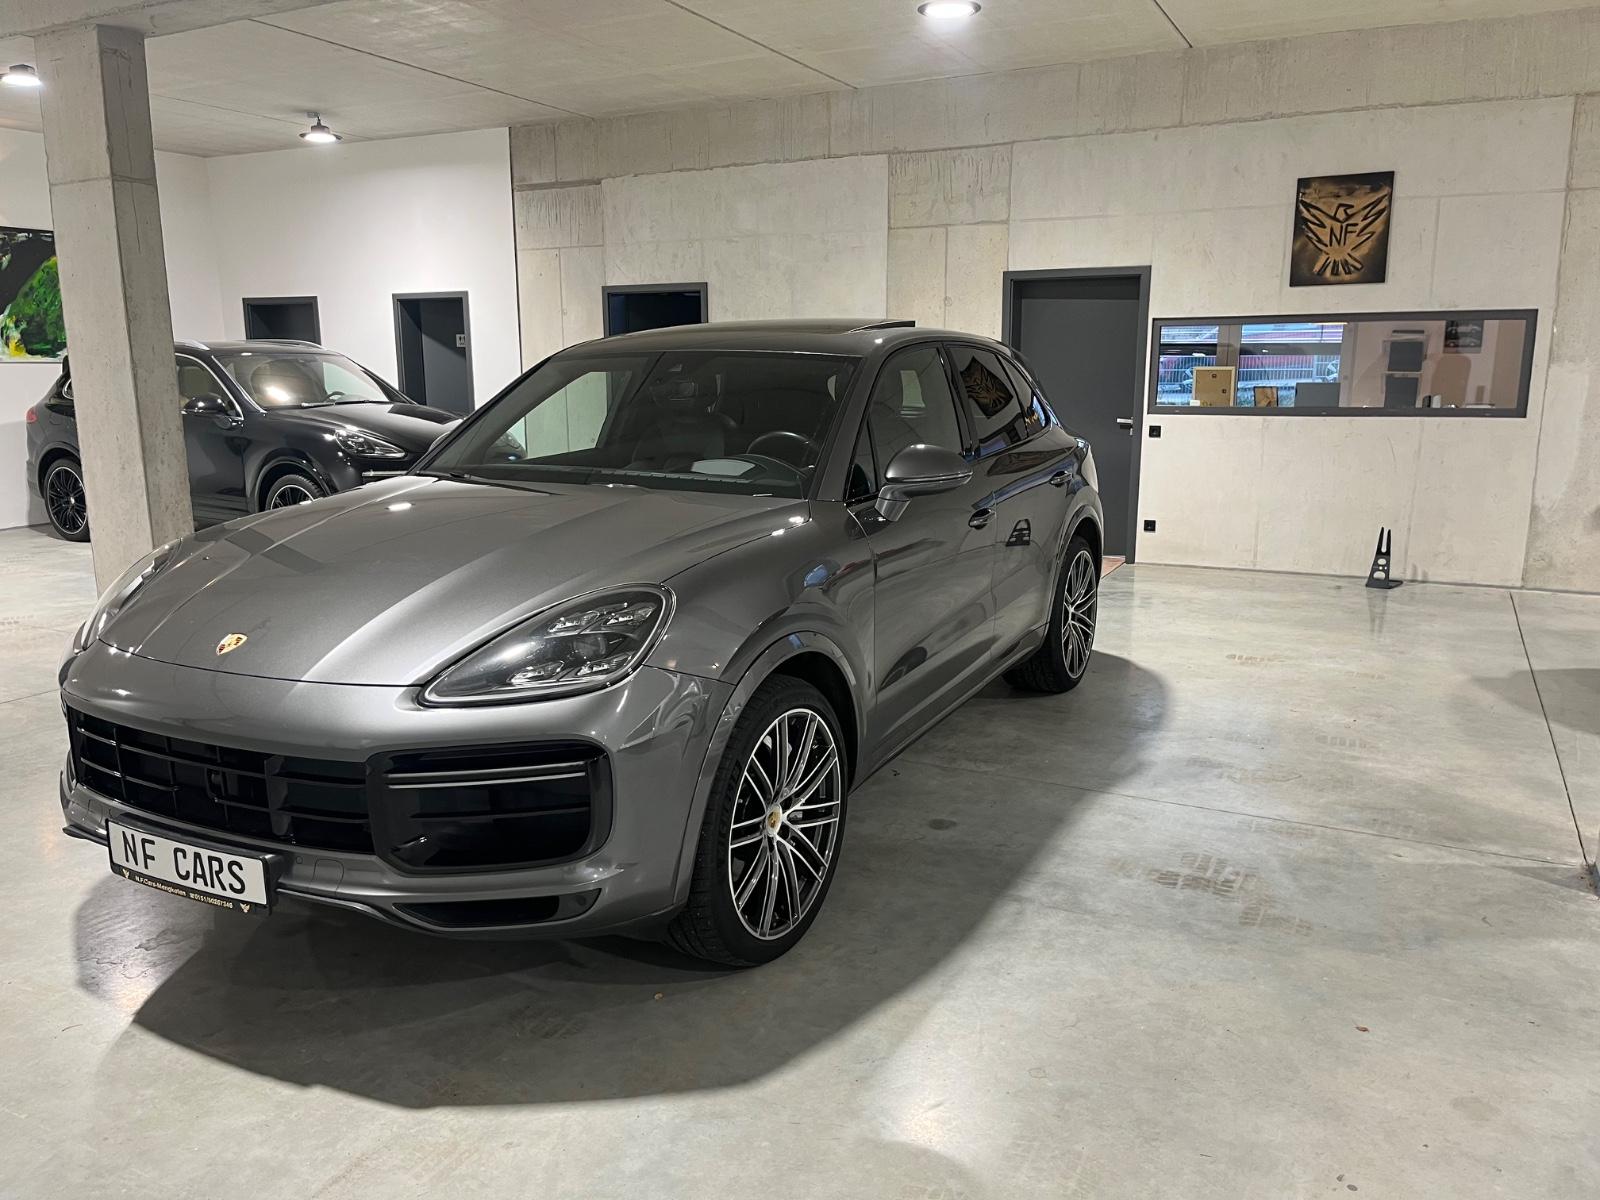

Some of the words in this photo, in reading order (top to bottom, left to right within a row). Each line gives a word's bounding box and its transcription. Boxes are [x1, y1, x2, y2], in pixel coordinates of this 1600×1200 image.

[1329, 223, 1358, 247] NF
[122, 831, 156, 870] NF
[173, 847, 246, 894] CARS
